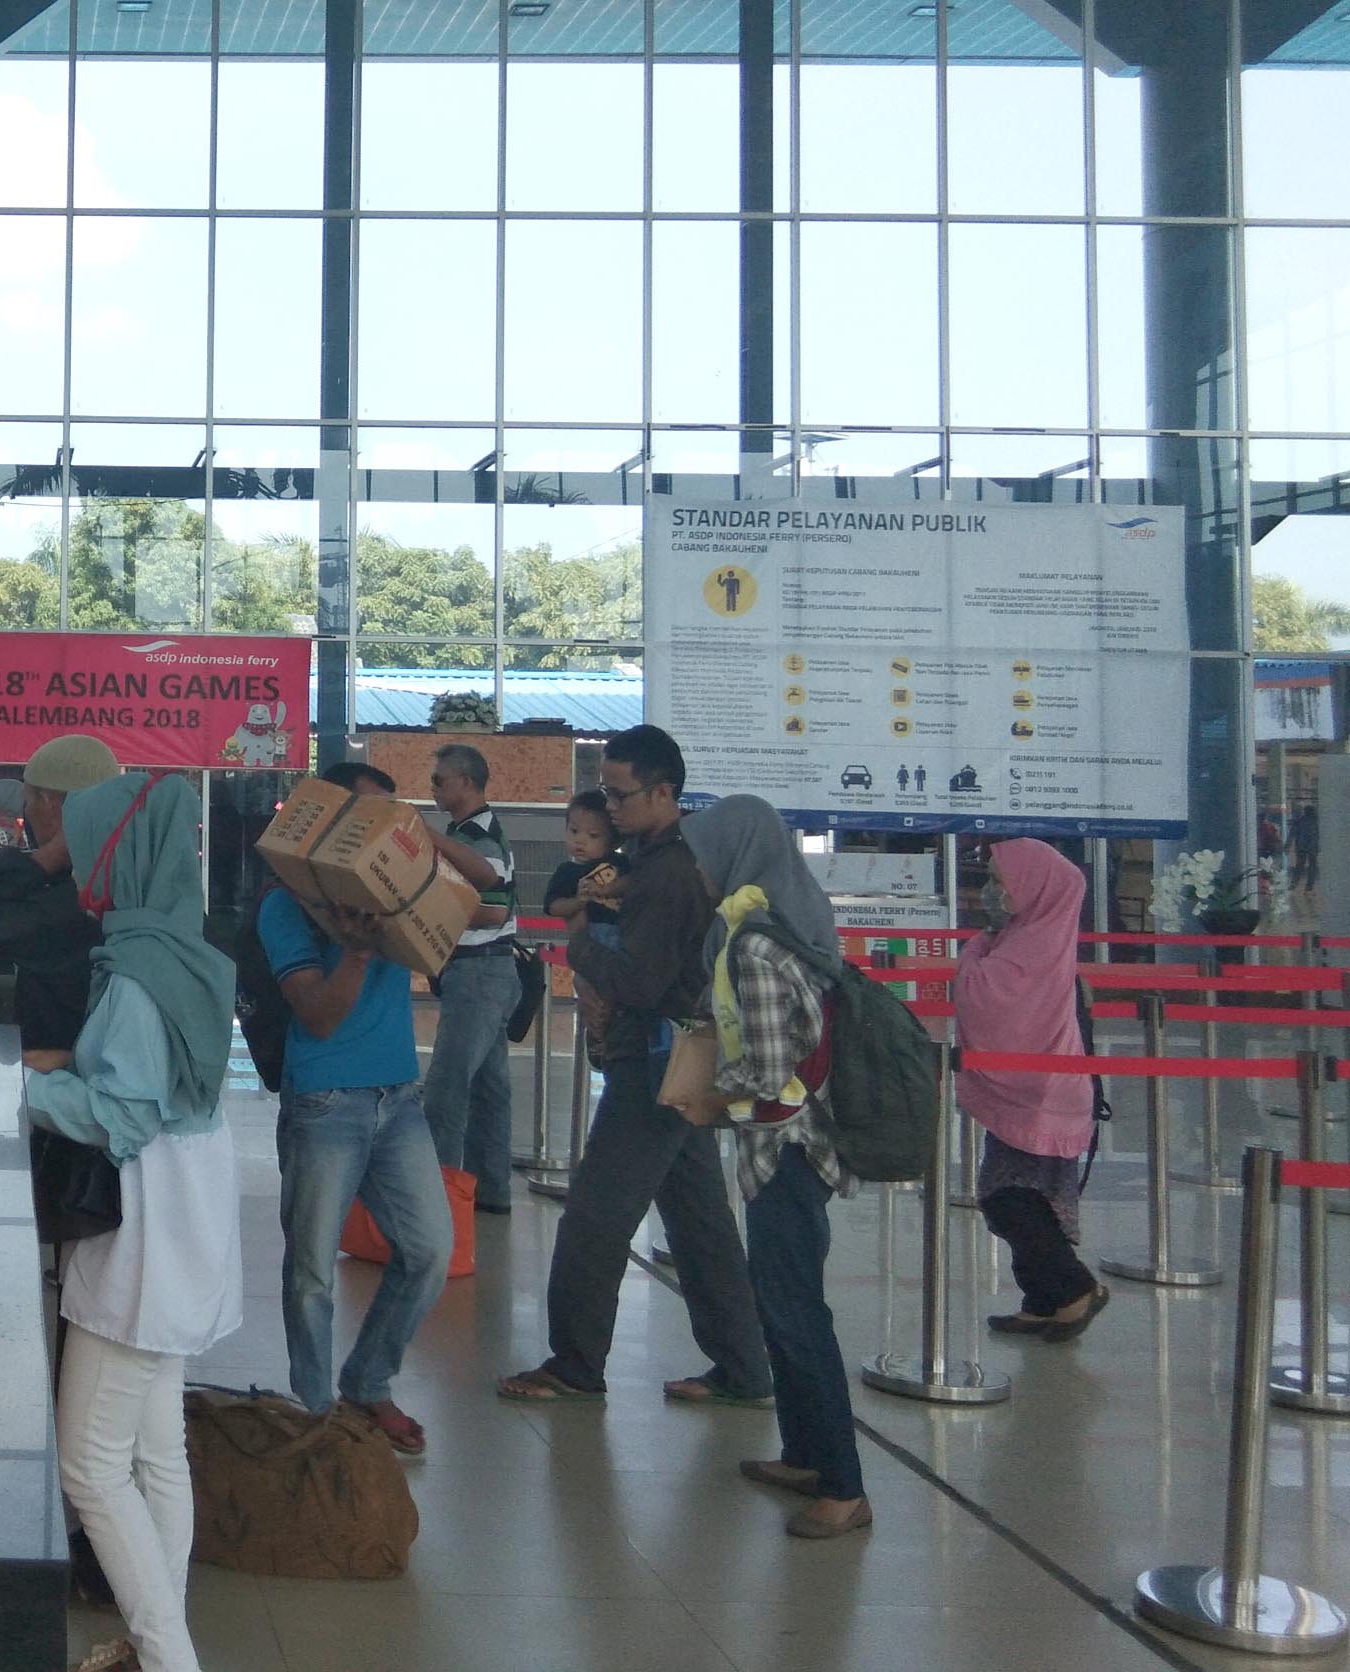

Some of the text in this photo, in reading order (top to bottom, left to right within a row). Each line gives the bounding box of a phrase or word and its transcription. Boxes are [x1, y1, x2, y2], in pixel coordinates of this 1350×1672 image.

[672, 508, 987, 533] STANDAR PELAYANAN PUBLIK
[672, 531, 852, 544] PT. ASDP INDONESIA FERRY (PERSERO)
[672, 543, 768, 553] CABANG BAKAUHENI
[145, 651, 280, 668] asdp indonesia ferry
[45, 671, 148, 698] ASIAN
[159, 673, 281, 701] GAMES
[143, 708, 200, 729] 2018
[891, 883, 906, 891] NO.
[833, 905, 941, 918] INDONESIA FERRY (Persero)
[847, 917, 895, 927] BAKAUHENI
